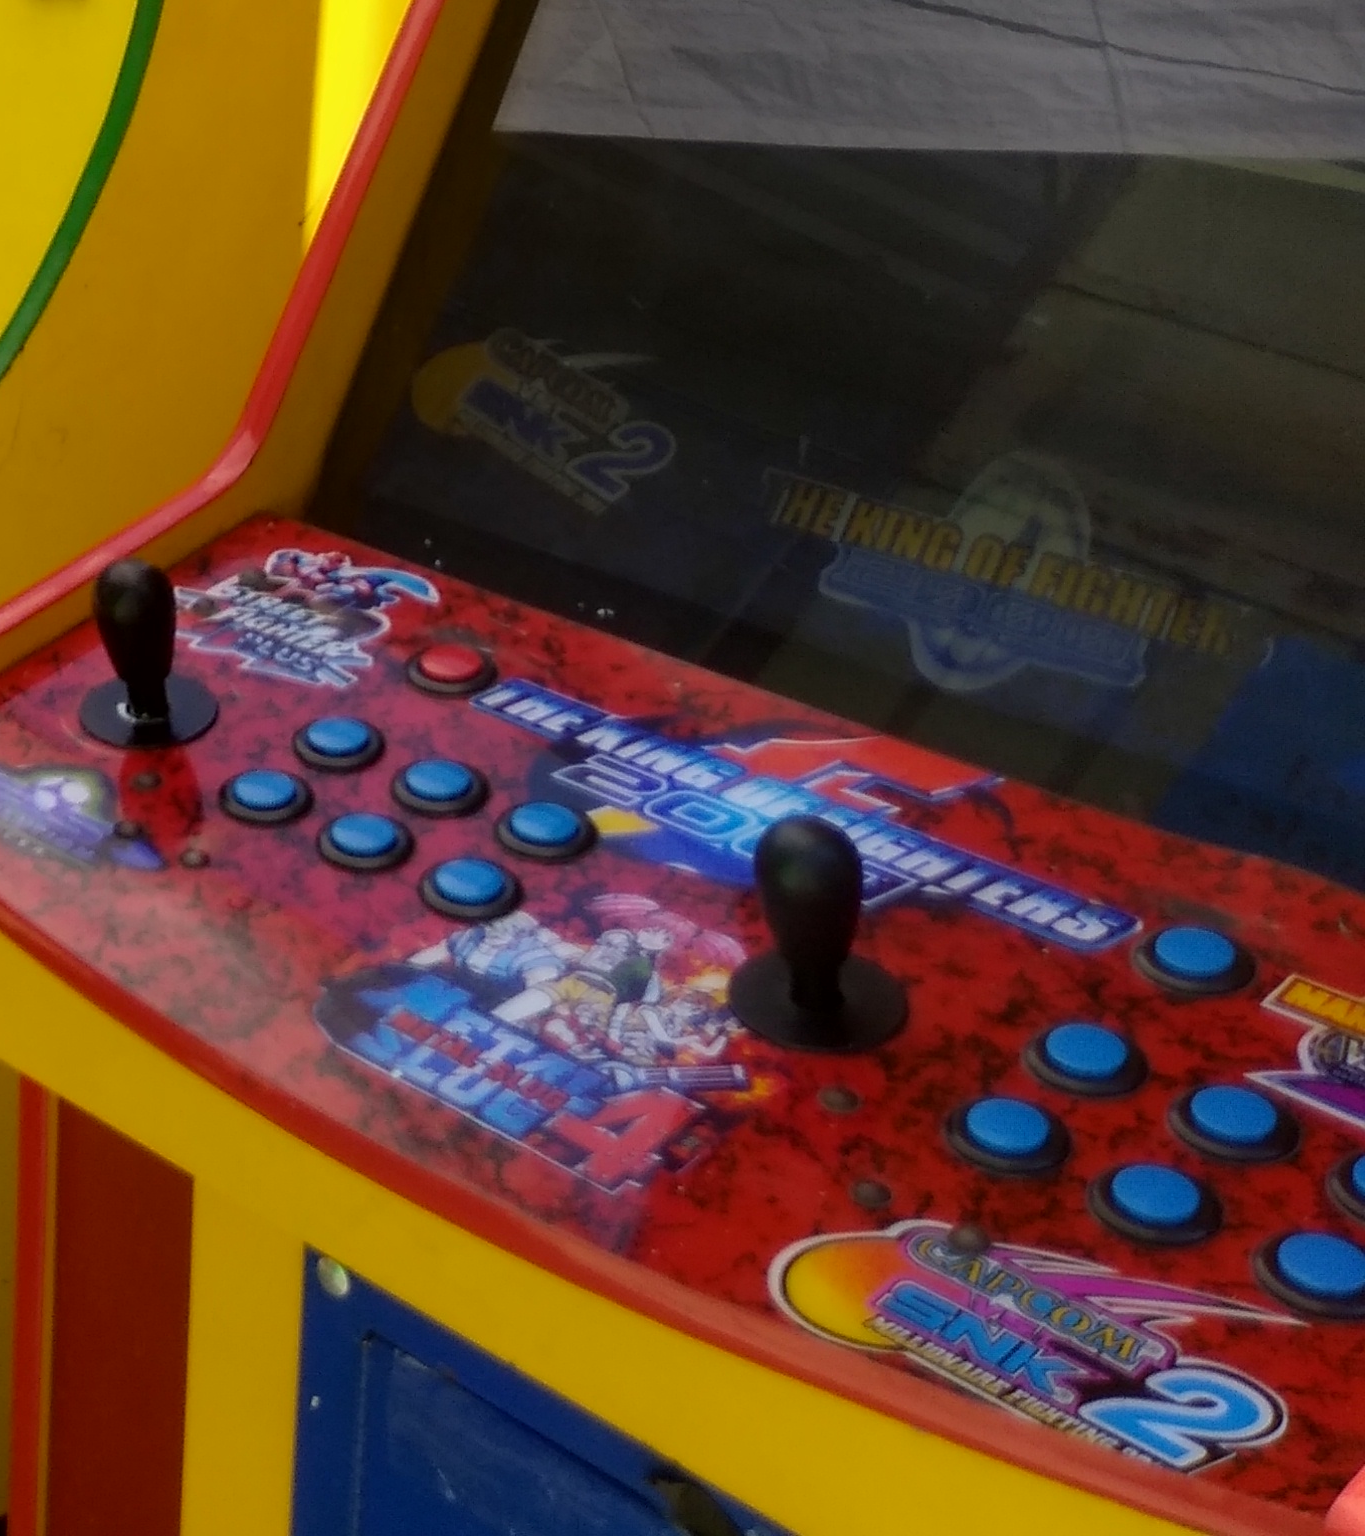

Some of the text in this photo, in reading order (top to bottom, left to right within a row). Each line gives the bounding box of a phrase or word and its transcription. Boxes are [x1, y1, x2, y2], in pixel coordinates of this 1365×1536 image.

[963, 533, 1028, 588] OF
[477, 682, 587, 736] THE
[575, 720, 745, 790] KING
[545, 1086, 705, 1186] 4
[914, 1233, 1145, 1368] CAPCOM
[875, 1284, 1281, 1468] SNK 2
